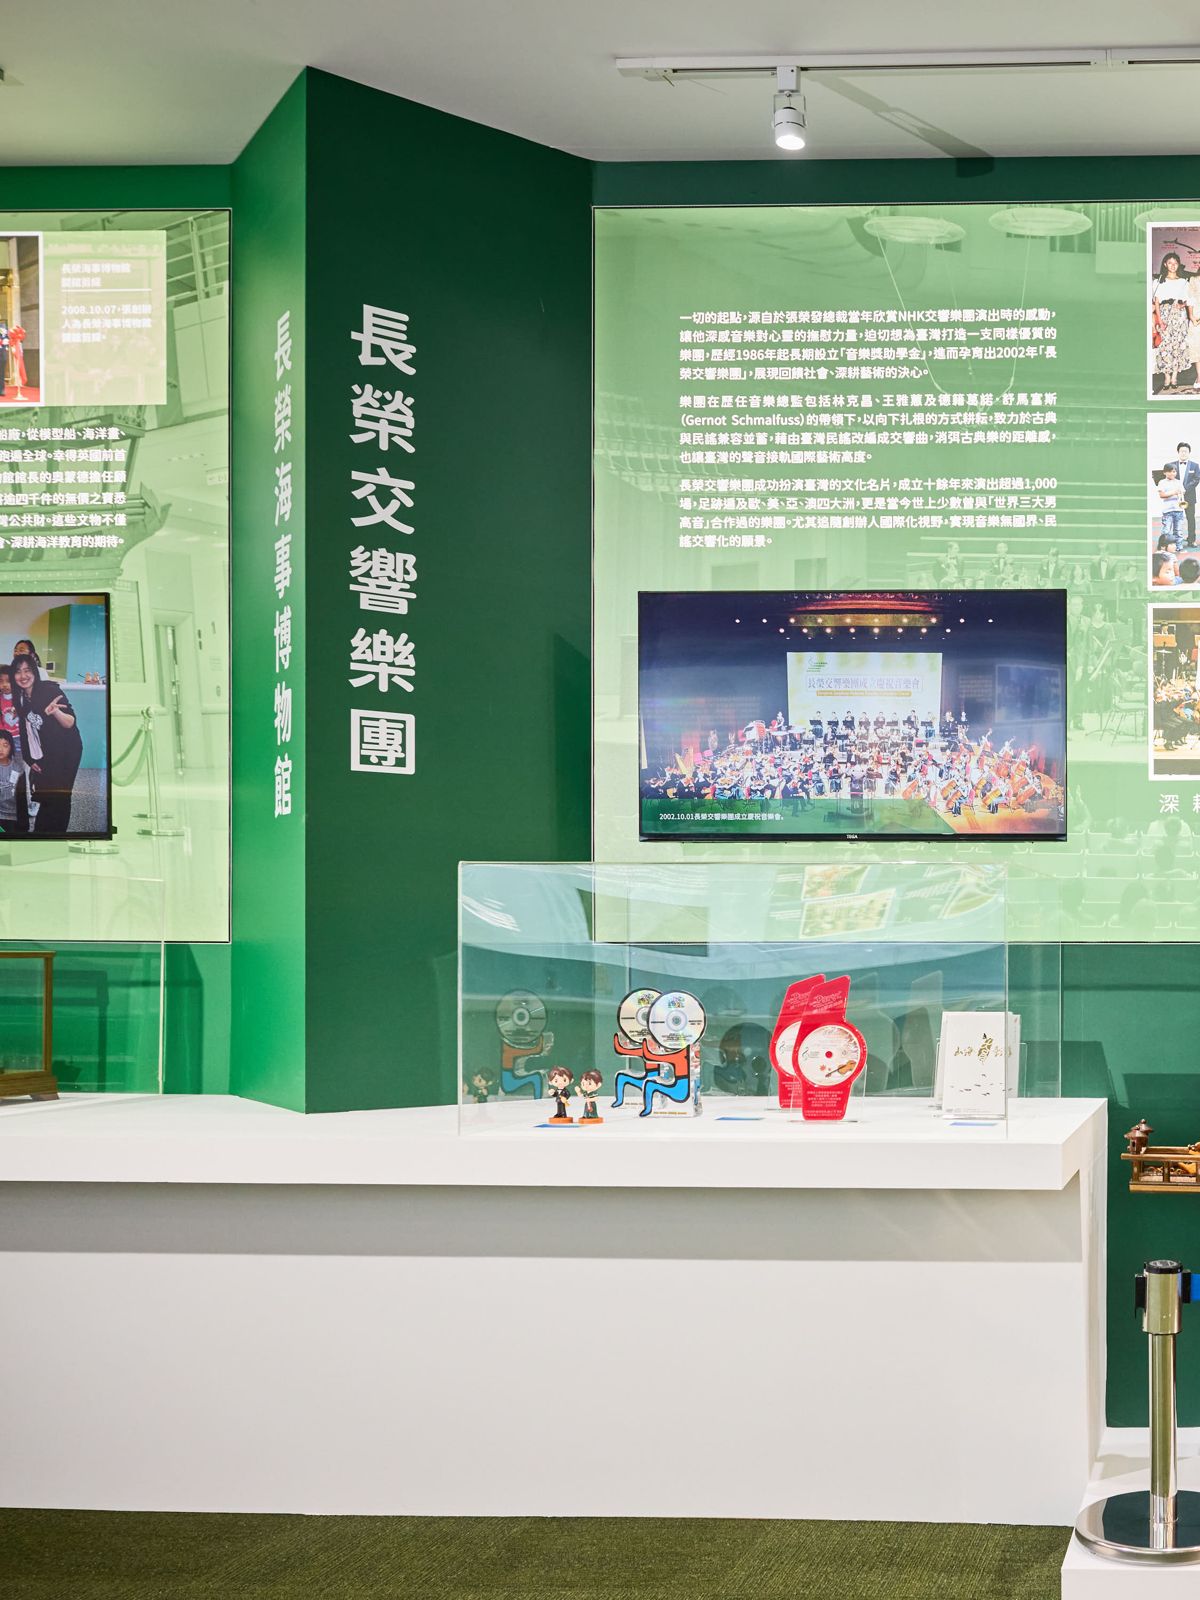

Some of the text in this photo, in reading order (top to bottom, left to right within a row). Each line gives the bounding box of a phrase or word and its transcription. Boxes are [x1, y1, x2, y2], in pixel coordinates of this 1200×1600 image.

[273, 310, 292, 819] 長榮海事博物館
[348, 304, 417, 774] 長榮交響樂團
